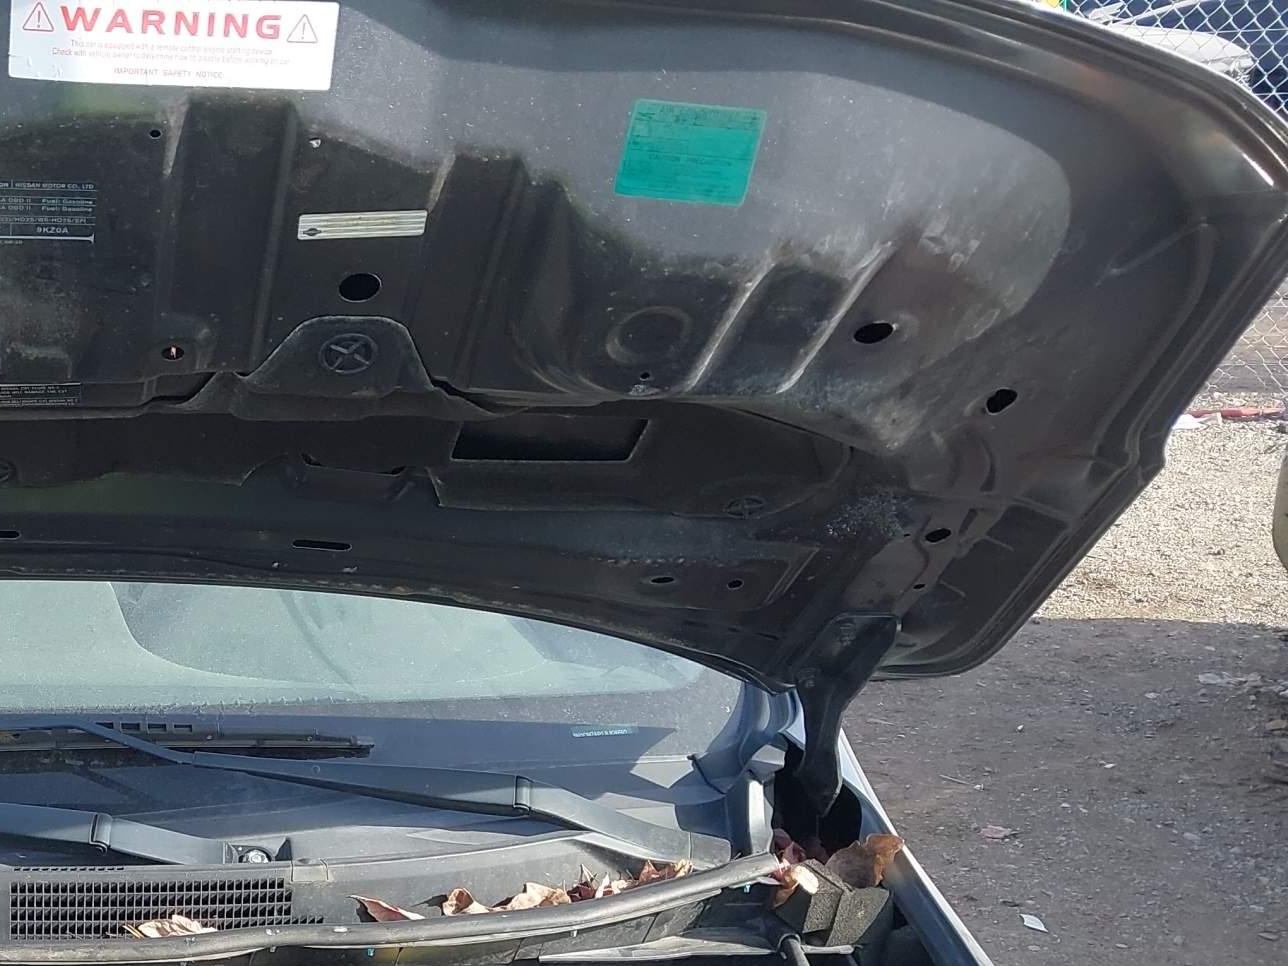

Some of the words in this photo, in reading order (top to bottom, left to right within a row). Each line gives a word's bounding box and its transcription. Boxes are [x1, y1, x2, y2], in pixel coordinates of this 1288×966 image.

[60, 5, 282, 40] WARNING
[113, 66, 159, 76] IMPORTANT
[162, 69, 192, 78] SAFETY
